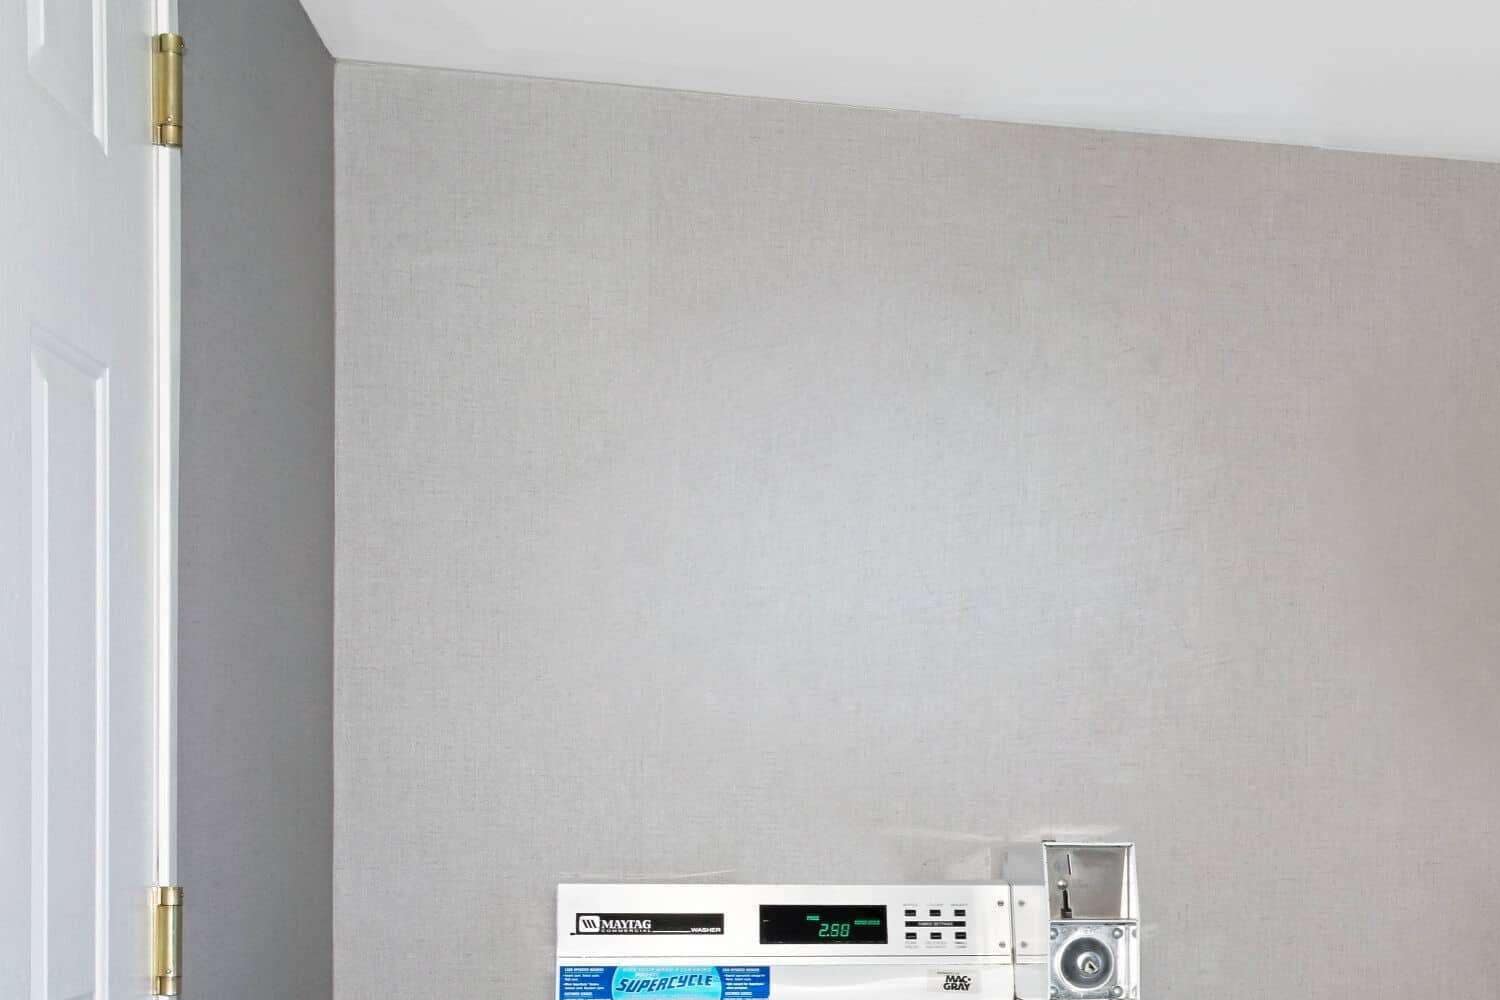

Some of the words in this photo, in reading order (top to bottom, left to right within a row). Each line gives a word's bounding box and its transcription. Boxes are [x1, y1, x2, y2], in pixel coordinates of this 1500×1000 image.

[601, 919, 651, 929] MAYTAG
[616, 975, 713, 993] SUPERCYCLE
[943, 982, 970, 991] GRAY
